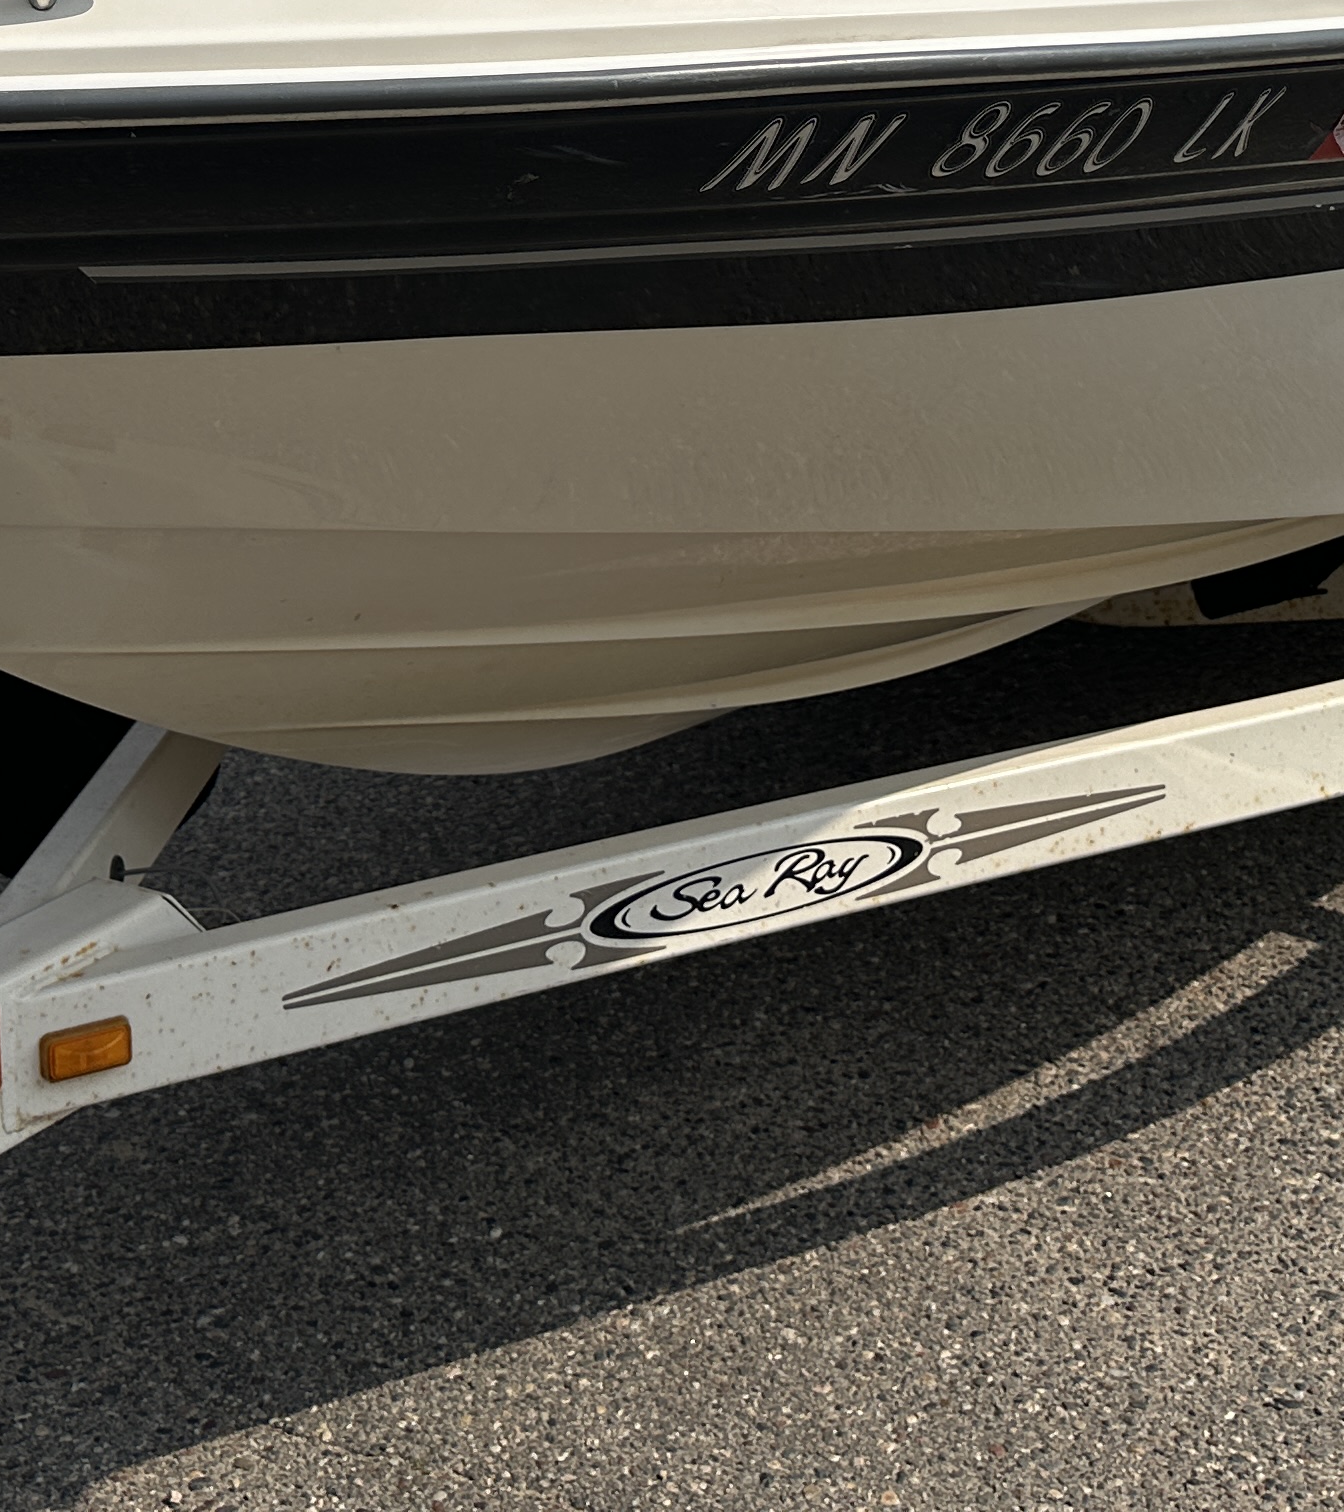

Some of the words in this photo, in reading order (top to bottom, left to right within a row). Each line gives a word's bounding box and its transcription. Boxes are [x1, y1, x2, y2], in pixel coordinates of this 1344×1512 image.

[699, 113, 909, 193] MN
[930, 96, 1154, 179] 8660
[649, 875, 758, 922] Sea
[763, 847, 870, 899] Ray
